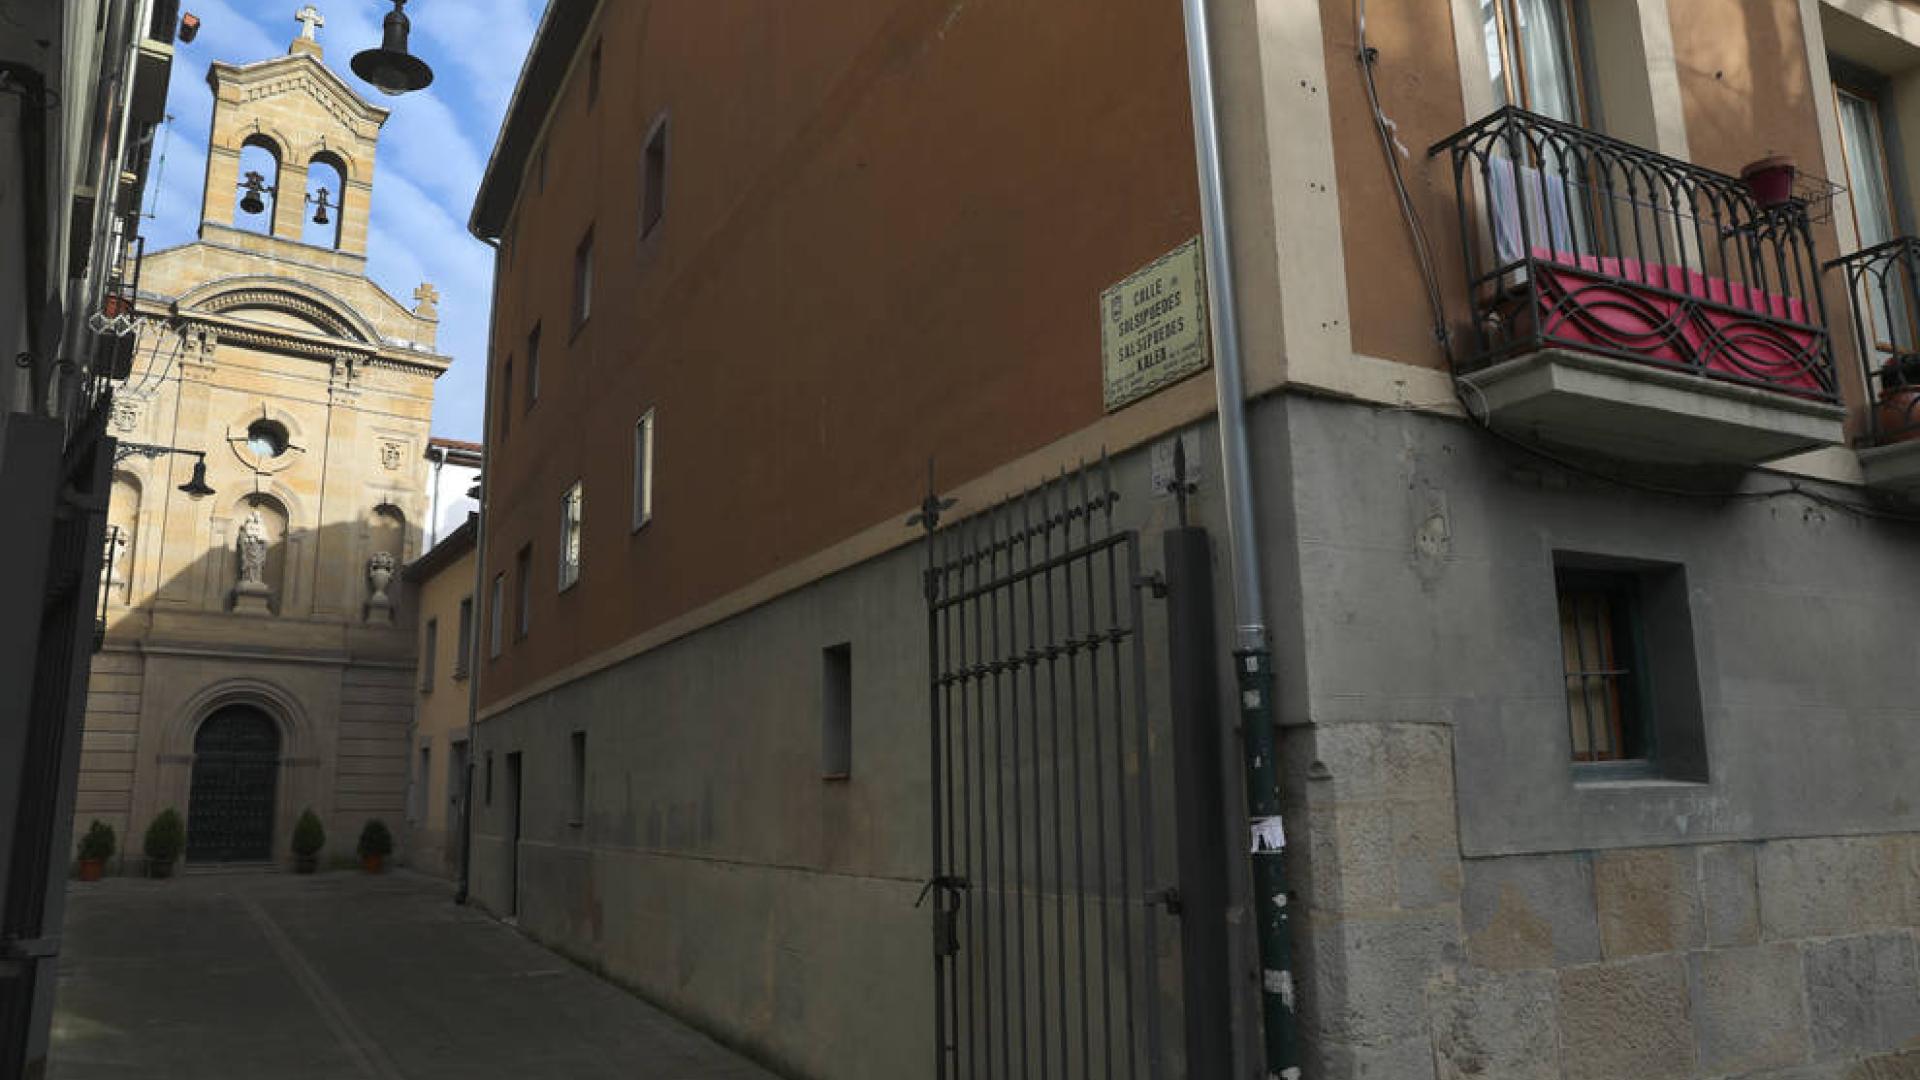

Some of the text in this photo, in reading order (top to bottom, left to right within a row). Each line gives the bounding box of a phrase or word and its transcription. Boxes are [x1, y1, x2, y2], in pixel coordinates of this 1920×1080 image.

[1119, 291, 1181, 337] SALSIPUEDES
[1134, 278, 1162, 306] CALLE
[1119, 317, 1184, 362] SALSIPUEDES
